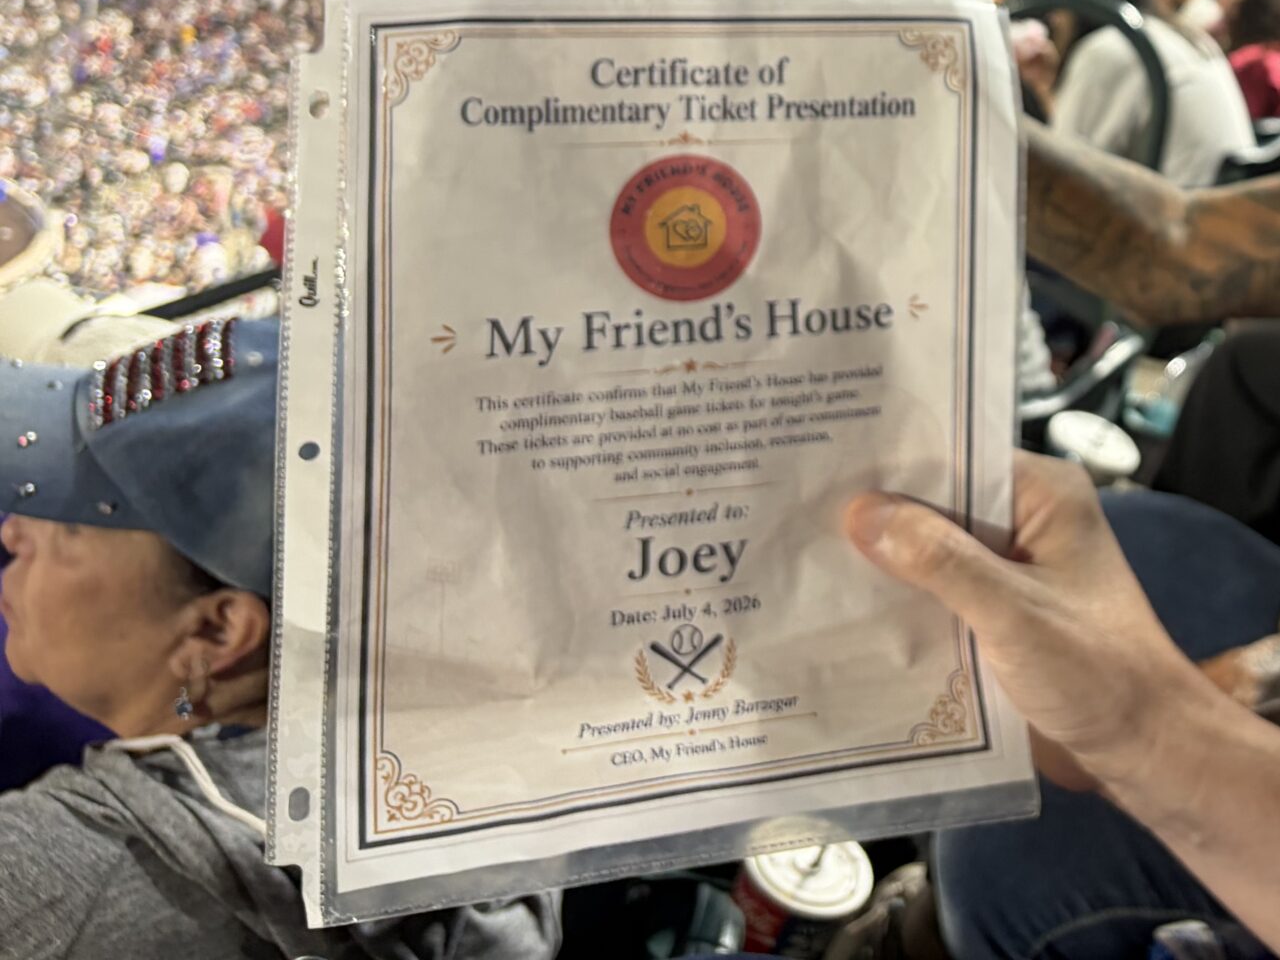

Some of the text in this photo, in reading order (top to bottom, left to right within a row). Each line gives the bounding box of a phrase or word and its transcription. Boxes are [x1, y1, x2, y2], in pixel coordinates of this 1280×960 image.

[590, 56, 790, 89] Certificate of
[460, 92, 917, 133] Complimentary Ticket Presentation
[485, 298, 894, 367] My Friend's House
[475, 395, 509, 413] This
[513, 390, 583, 410] certificate
[587, 385, 648, 403] confirms
[651, 382, 678, 397] that
[682, 380, 704, 395] My
[709, 375, 761, 393] Friend's
[766, 373, 806, 388] House
[809, 370, 829, 384] has
[499, 406, 607, 431] complimentary
[609, 404, 664, 422] baseball
[666, 404, 700, 420] game
[706, 399, 745, 414] tickets
[750, 395, 766, 409] for
[477, 438, 519, 455] These
[523, 433, 570, 451] tickets
[573, 432, 595, 446] are
[598, 425, 657, 447] provided
[659, 425, 675, 437] at
[677, 424, 695, 437] no
[697, 421, 723, 435] cost
[726, 421, 740, 432] as
[743, 417, 769, 434] part
[770, 413, 785, 427] of
[531, 457, 546, 470] to
[549, 451, 624, 471] supporting
[626, 444, 700, 462] community
[614, 467, 639, 482] and
[642, 464, 680, 479] social
[624, 501, 750, 531] Presented to:
[627, 535, 749, 583] Joey
[610, 594, 762, 628] Date: July 4, 2026
[578, 713, 654, 738] Presented
[658, 711, 681, 728] by:
[684, 705, 730, 725] Jenny
[610, 732, 768, 767] CEO, My Friend's House
